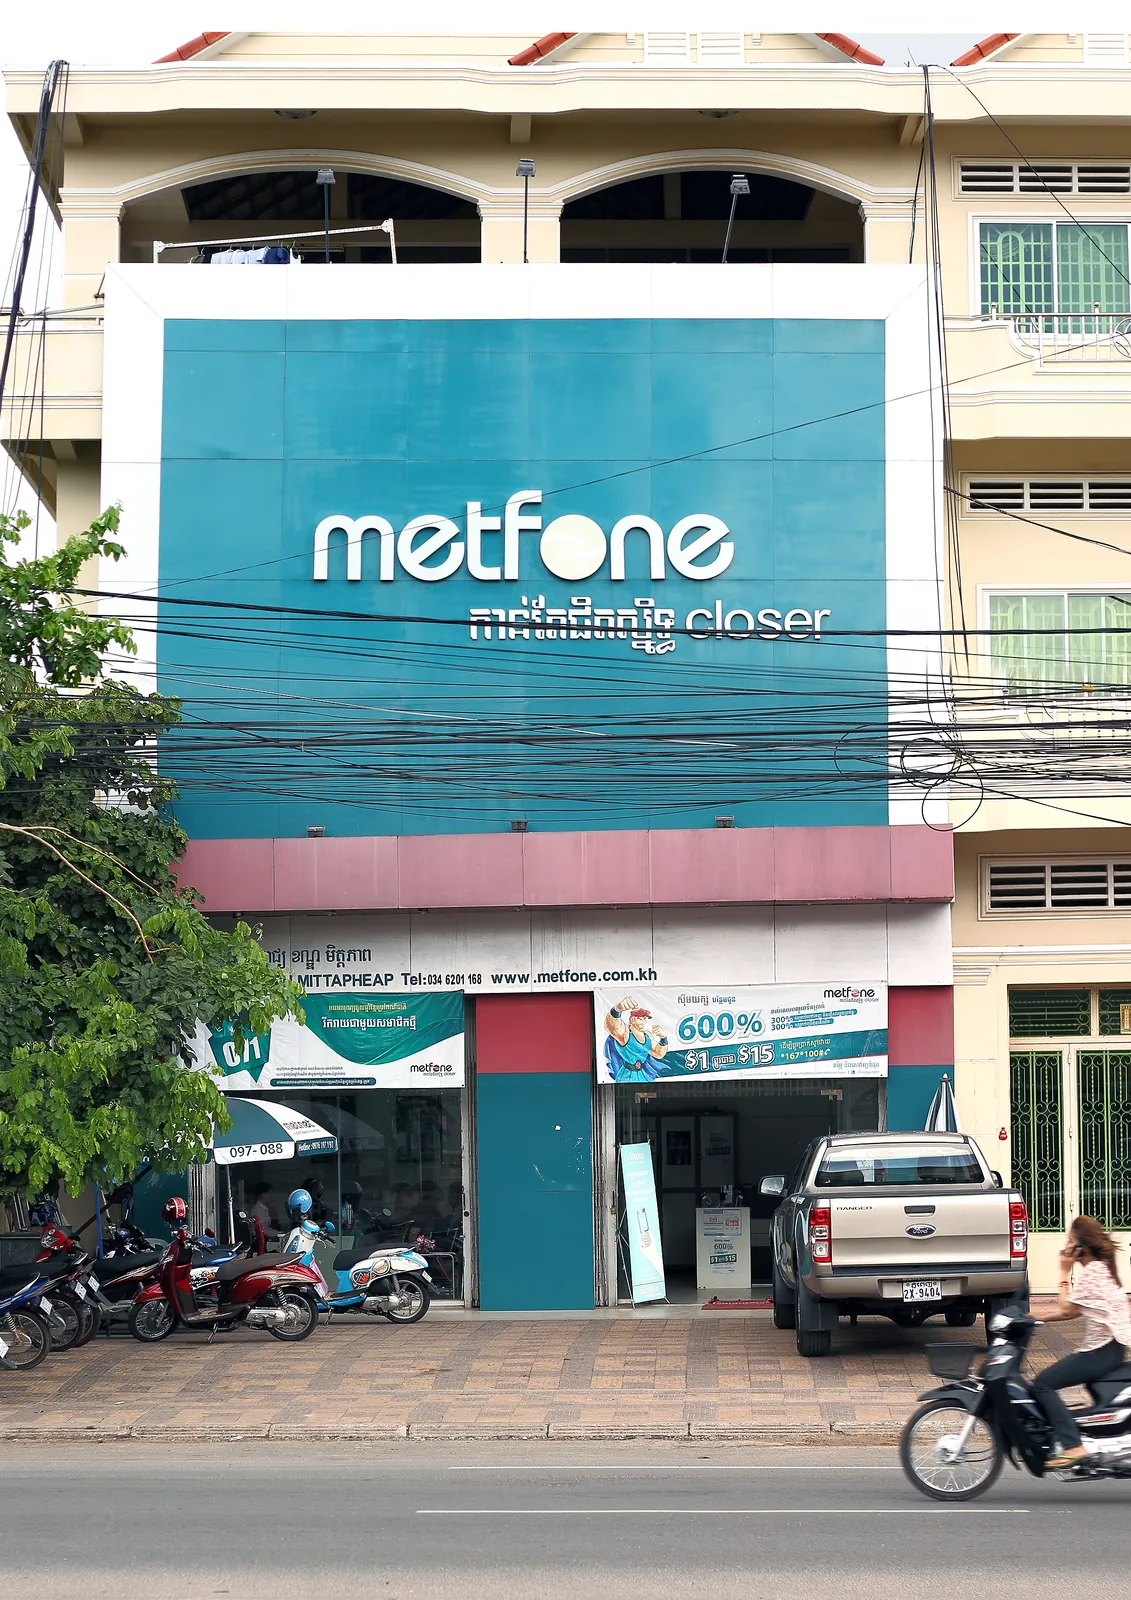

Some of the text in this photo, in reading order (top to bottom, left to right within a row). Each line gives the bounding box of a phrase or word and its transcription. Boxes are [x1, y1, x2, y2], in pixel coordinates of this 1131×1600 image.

[313, 490, 735, 581] metfone
[685, 599, 832, 640] closer
[325, 944, 372, 968] មិត្តភាព
[297, 973, 394, 988] MITTAPHEAP
[445, 973, 465, 986] 6201
[468, 973, 482, 985] 168
[823, 986, 876, 998] metfone
[678, 1012, 763, 1041] 600%
[410, 1062, 453, 1072] metfone
[685, 1050, 708, 1070] $1
[738, 1044, 774, 1065] $15
[260, 1143, 283, 1155] 088
